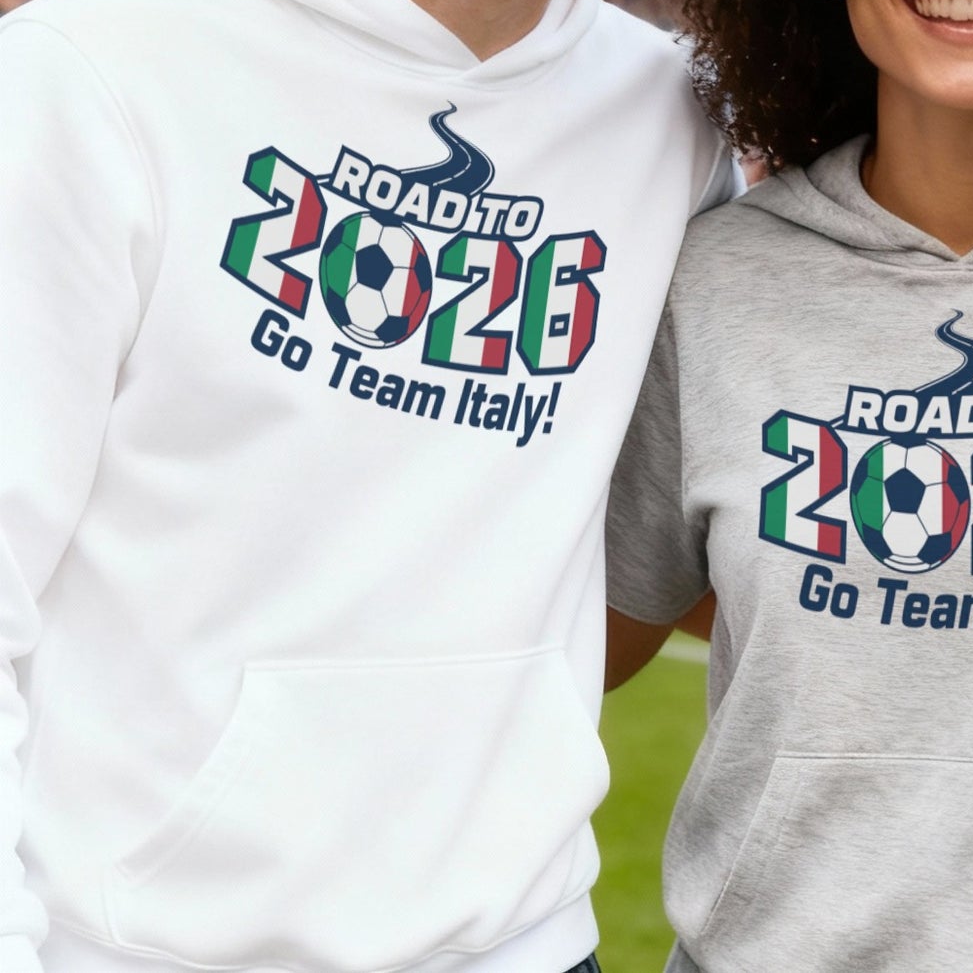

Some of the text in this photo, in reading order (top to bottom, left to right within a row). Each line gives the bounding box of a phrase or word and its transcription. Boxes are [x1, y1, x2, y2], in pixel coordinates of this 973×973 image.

[331, 146, 544, 241] ROAD TO
[219, 145, 608, 376] 2026
[250, 308, 562, 448] Go Team Italy!
[799, 563, 859, 619] Go
